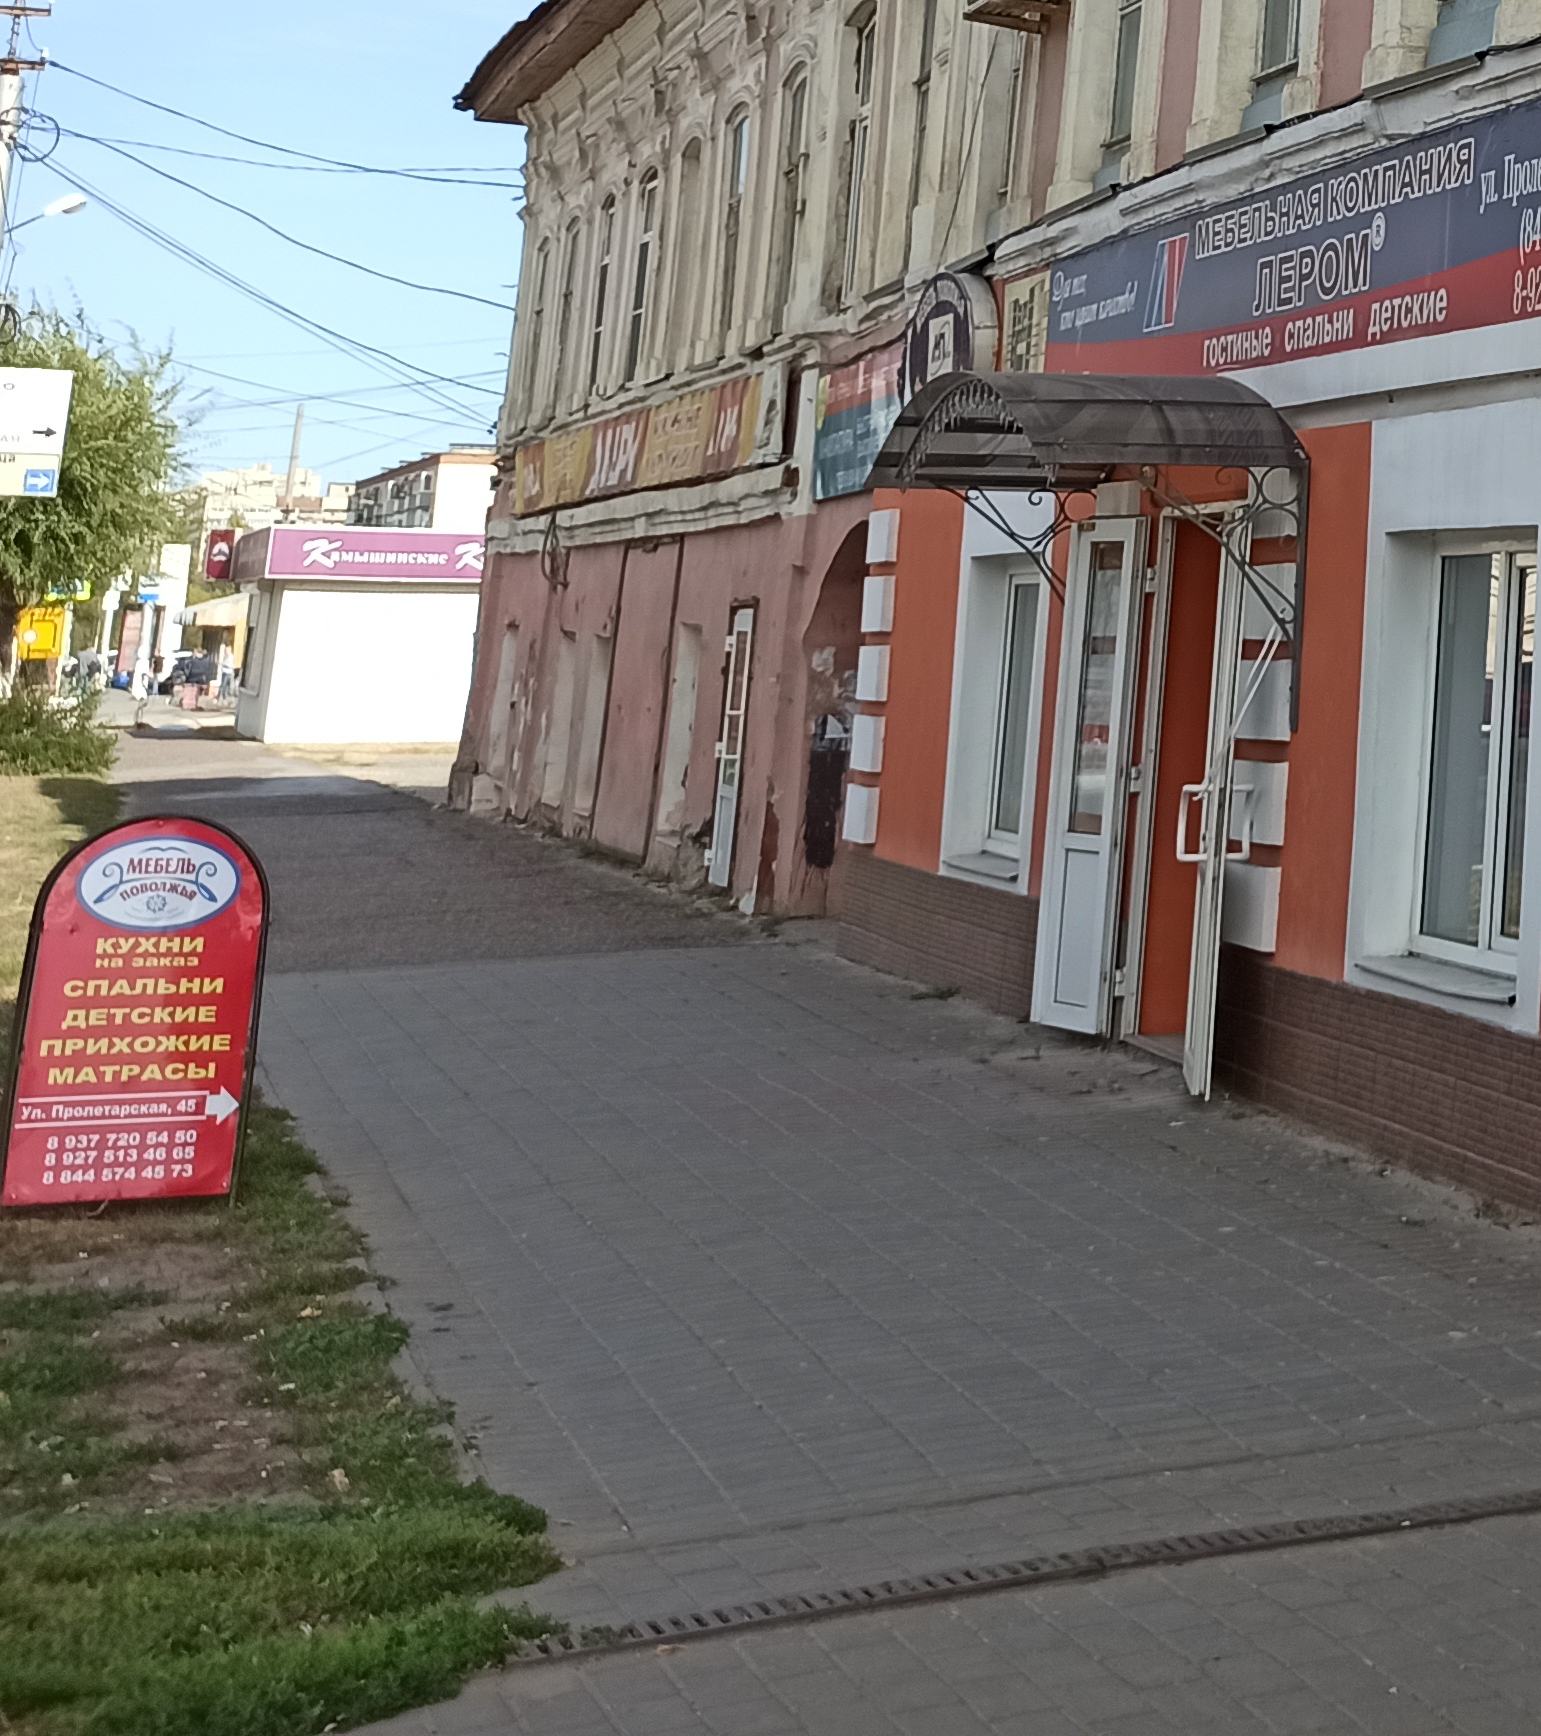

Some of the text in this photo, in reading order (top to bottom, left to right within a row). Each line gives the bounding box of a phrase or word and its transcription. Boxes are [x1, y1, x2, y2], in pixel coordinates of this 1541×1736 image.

[1195, 137, 1475, 260] МЕБЕЛЬНАЯ КОМПАНИЯ
[1479, 169, 1499, 215] ул.
[1203, 287, 1448, 368] гостиные спальни детские
[126, 857, 197, 876] МЕБЕЛЬ
[95, 935, 206, 955] КУХНИ
[95, 955, 199, 969] на заказ
[63, 977, 225, 998] СПАЛЬНИ
[60, 1005, 218, 1031] ДЕТСКИЕ
[39, 1034, 232, 1058] ПРИХОЖИЕ
[47, 1062, 217, 1086] МАТРАСЫ
[20, 1099, 197, 1121] Ул. Пролетарская, 45
[47, 1129, 197, 1150] 8 937 720 54 50
[44, 1152, 56, 1166] 8
[62, 1150, 98, 1165] 927
[103, 1149, 138, 1163] 513
[42, 1163, 193, 1185] 8 844 574 45 73
